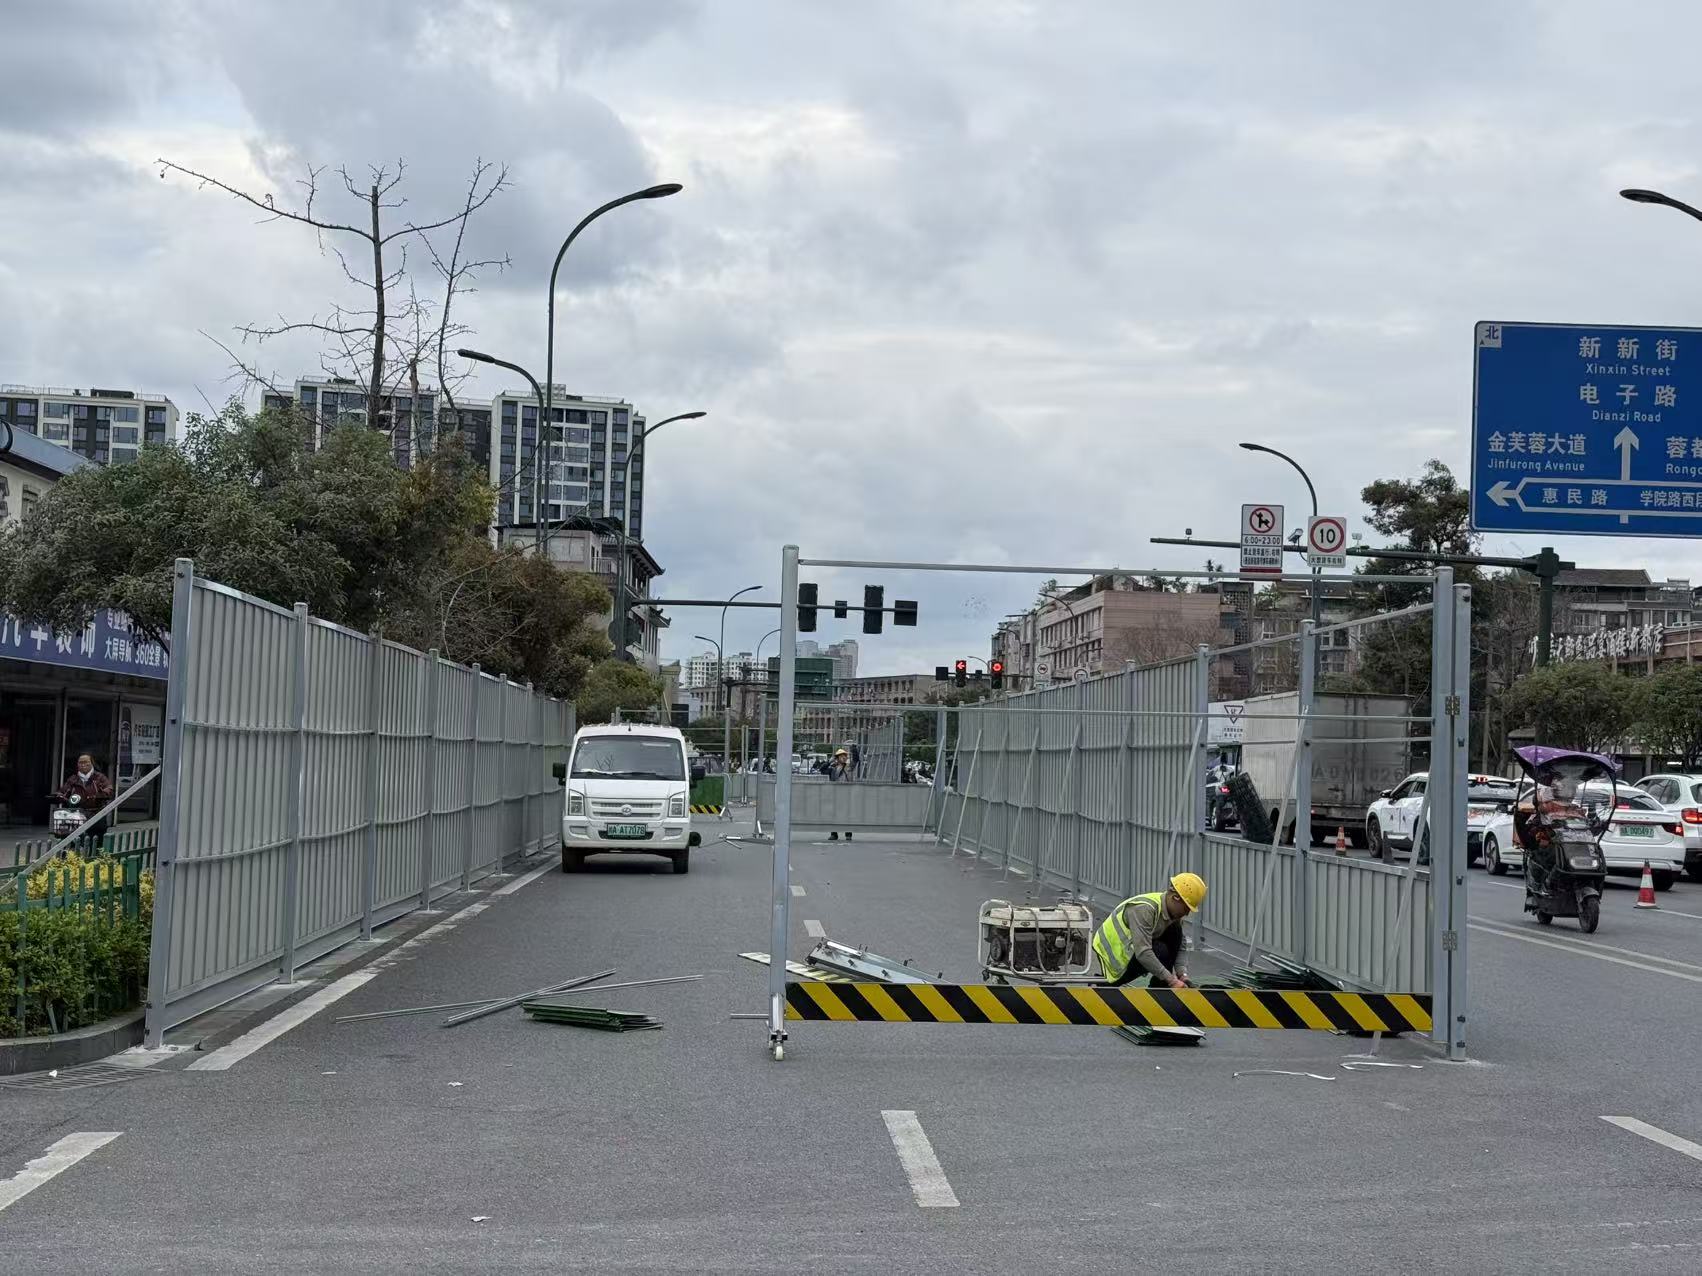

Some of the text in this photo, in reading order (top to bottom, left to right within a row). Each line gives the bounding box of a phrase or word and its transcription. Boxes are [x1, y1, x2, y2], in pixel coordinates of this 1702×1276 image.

[1485, 325, 1499, 340] 北
[1578, 336, 1678, 361] 新新街
[1586, 363, 1671, 377] Xinxin Street
[1579, 382, 1677, 408] 电子路
[1592, 410, 1661, 422] Dianzi Road
[1487, 431, 1587, 456] 金芙蓉大道
[1487, 458, 1585, 472] Jinfurong Avenue
[1542, 488, 1608, 506] 惠民路
[1319, 528, 1336, 544] 10
